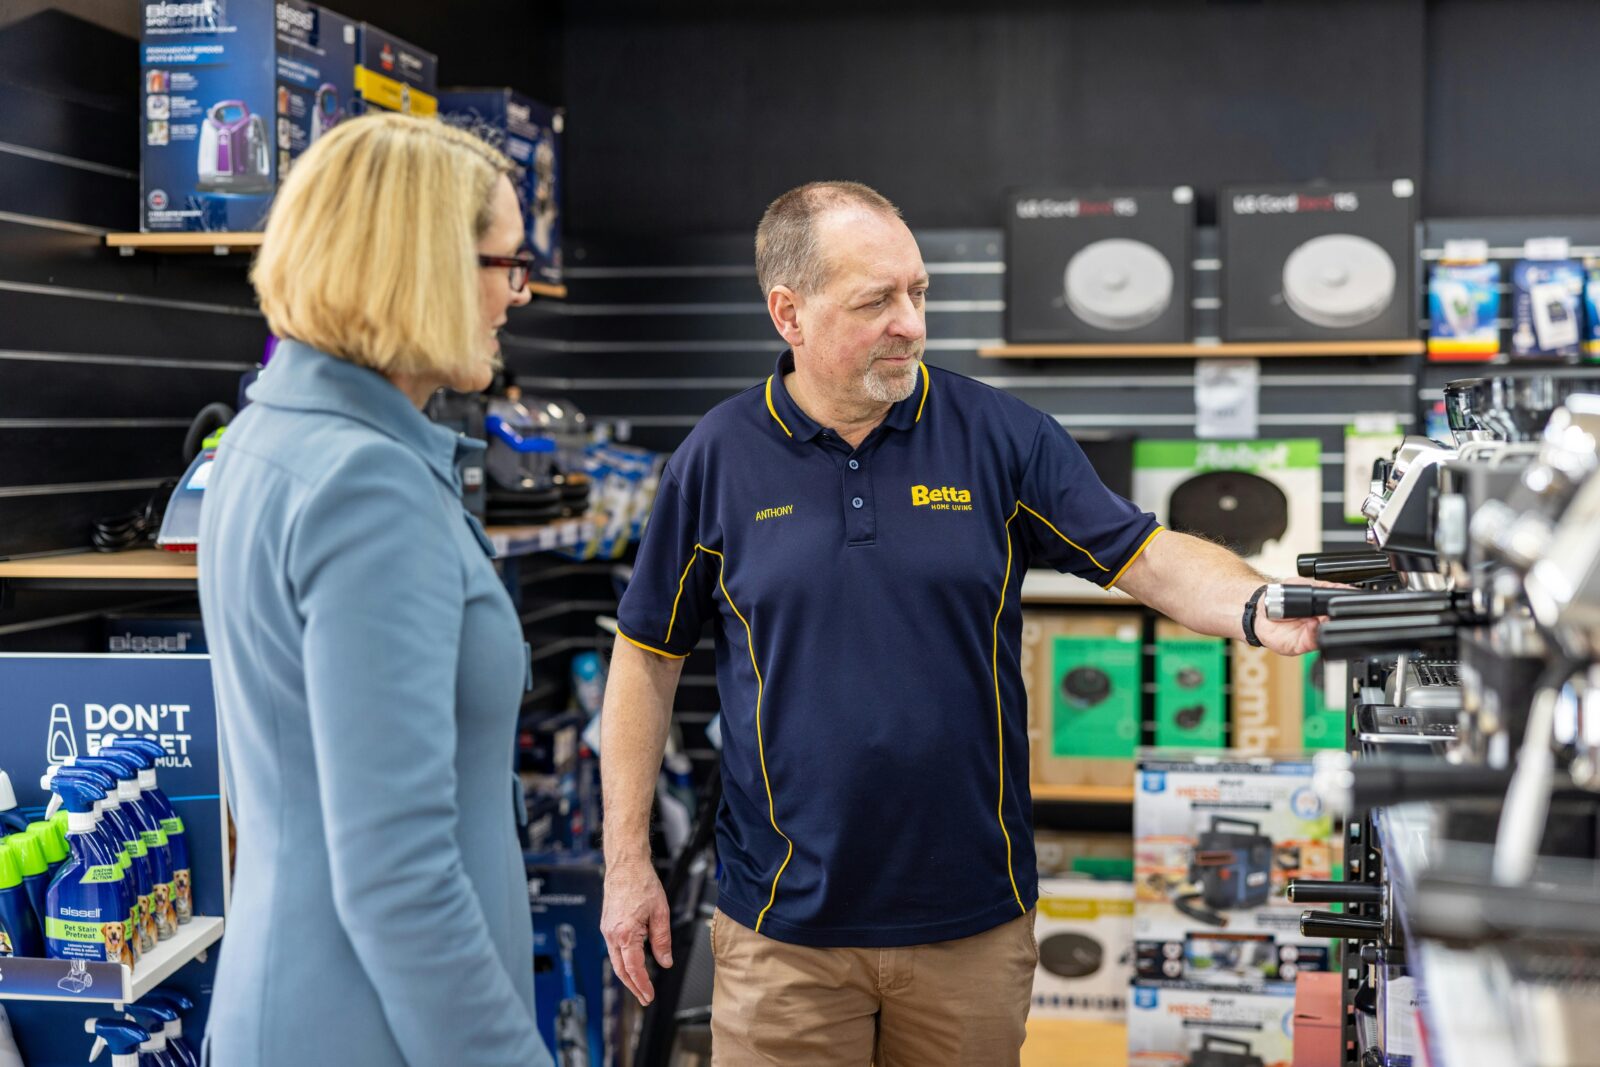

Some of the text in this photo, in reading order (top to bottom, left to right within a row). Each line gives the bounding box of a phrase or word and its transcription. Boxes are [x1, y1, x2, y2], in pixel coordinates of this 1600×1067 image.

[911, 484, 971, 507] Betta
[755, 505, 794, 521] ANTHONY
[84, 703, 190, 732] DON'T
[66, 931, 96, 939] Pretreat
